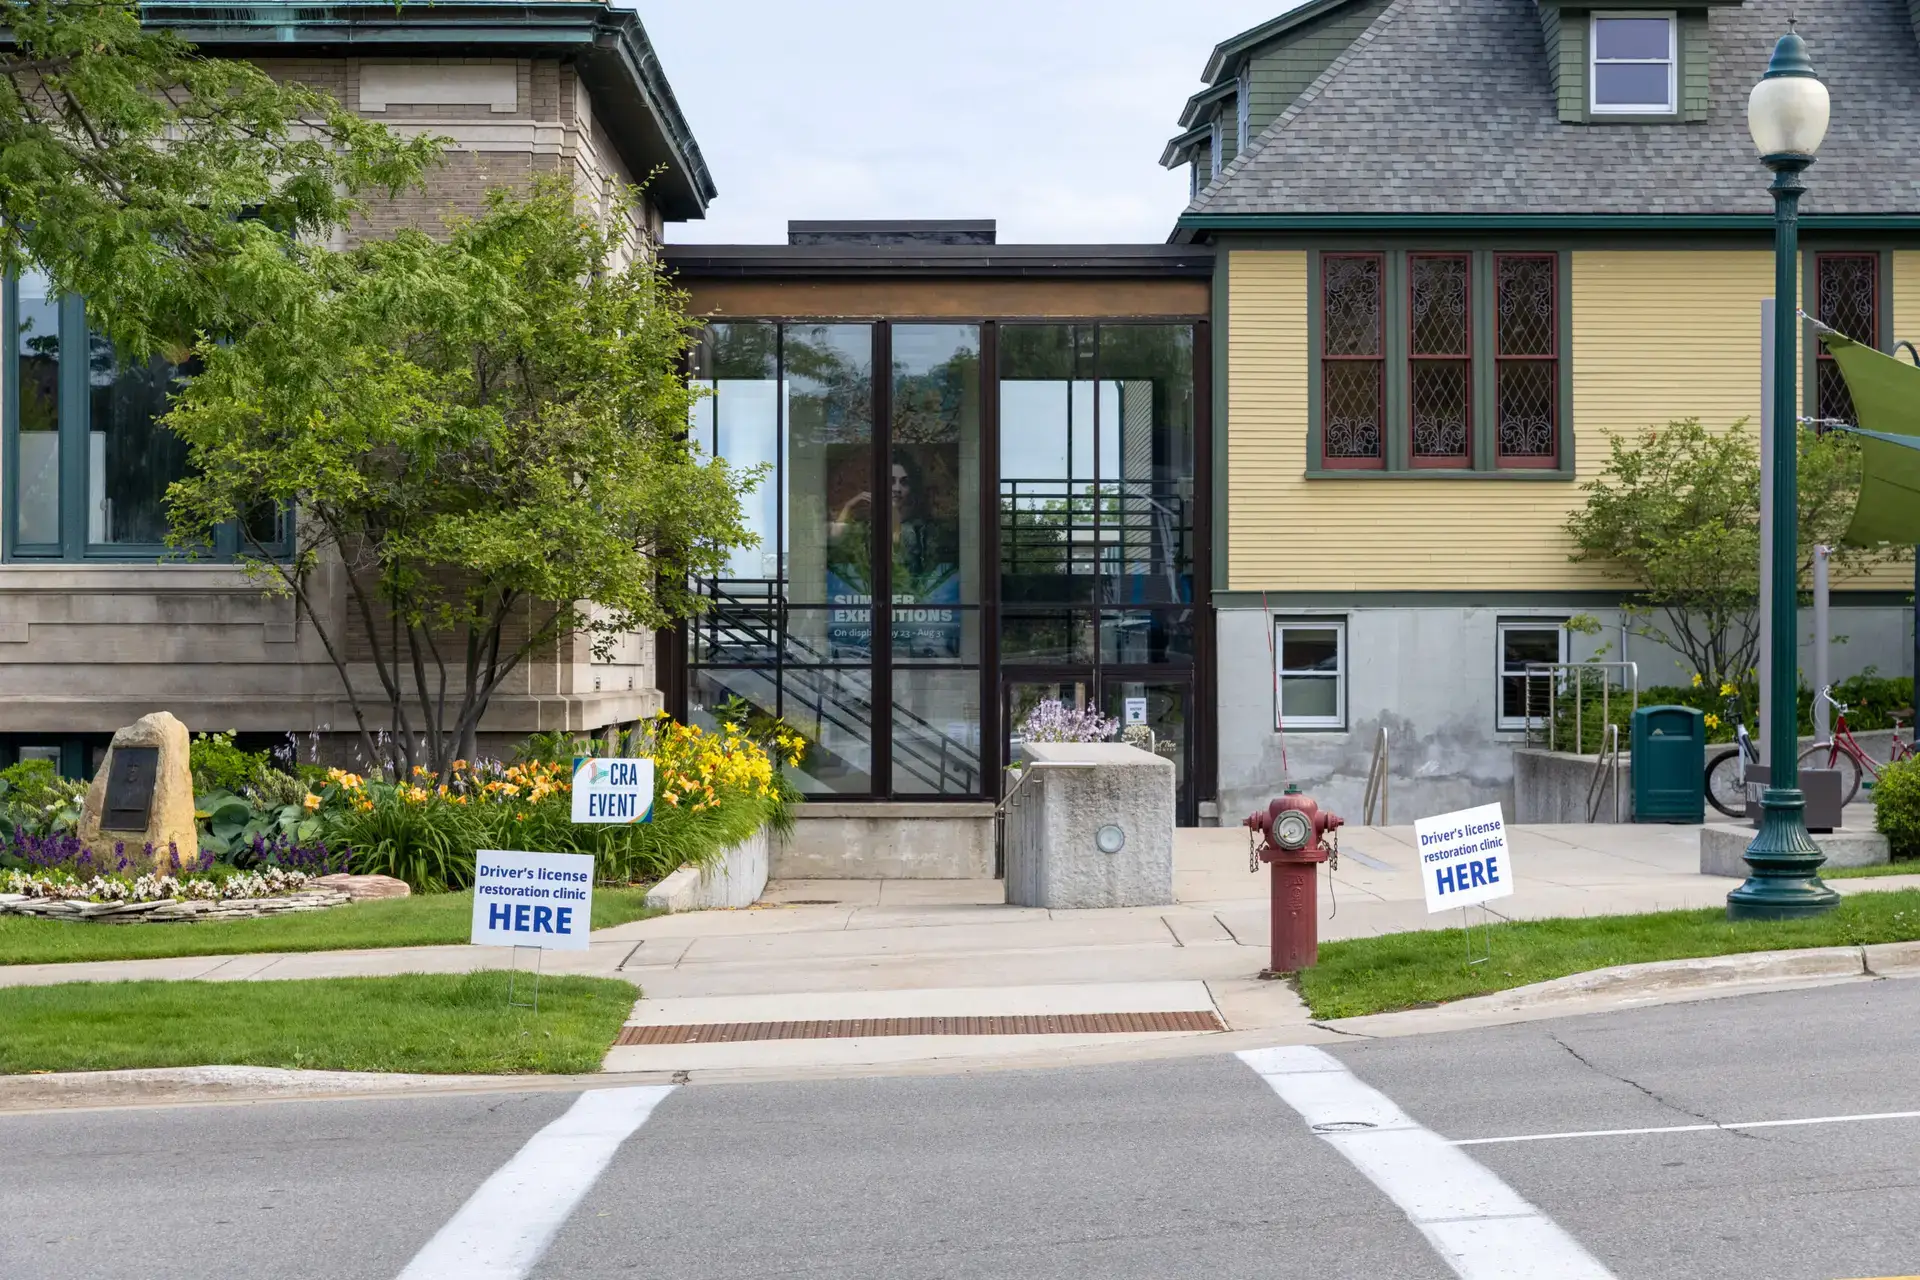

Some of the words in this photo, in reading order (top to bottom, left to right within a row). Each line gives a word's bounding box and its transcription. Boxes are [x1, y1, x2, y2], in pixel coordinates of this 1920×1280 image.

[834, 594, 915, 605] SUMER
[834, 609, 953, 622] EXHITIONS
[834, 629, 847, 637] On
[900, 630, 911, 638] 23
[917, 628, 935, 639] Aug
[610, 763, 638, 785] CRA
[589, 793, 637, 817] EVENT
[1421, 828, 1463, 846] Driver's
[1465, 820, 1501, 837] license
[1424, 844, 1478, 863] restoration
[1480, 837, 1504, 851] clinic
[480, 865, 534, 880] Driver's
[538, 868, 588, 882] license
[1436, 857, 1499, 895] HERE
[479, 885, 549, 898] restoration
[553, 887, 586, 900] clinic
[489, 903, 573, 934] HERE
